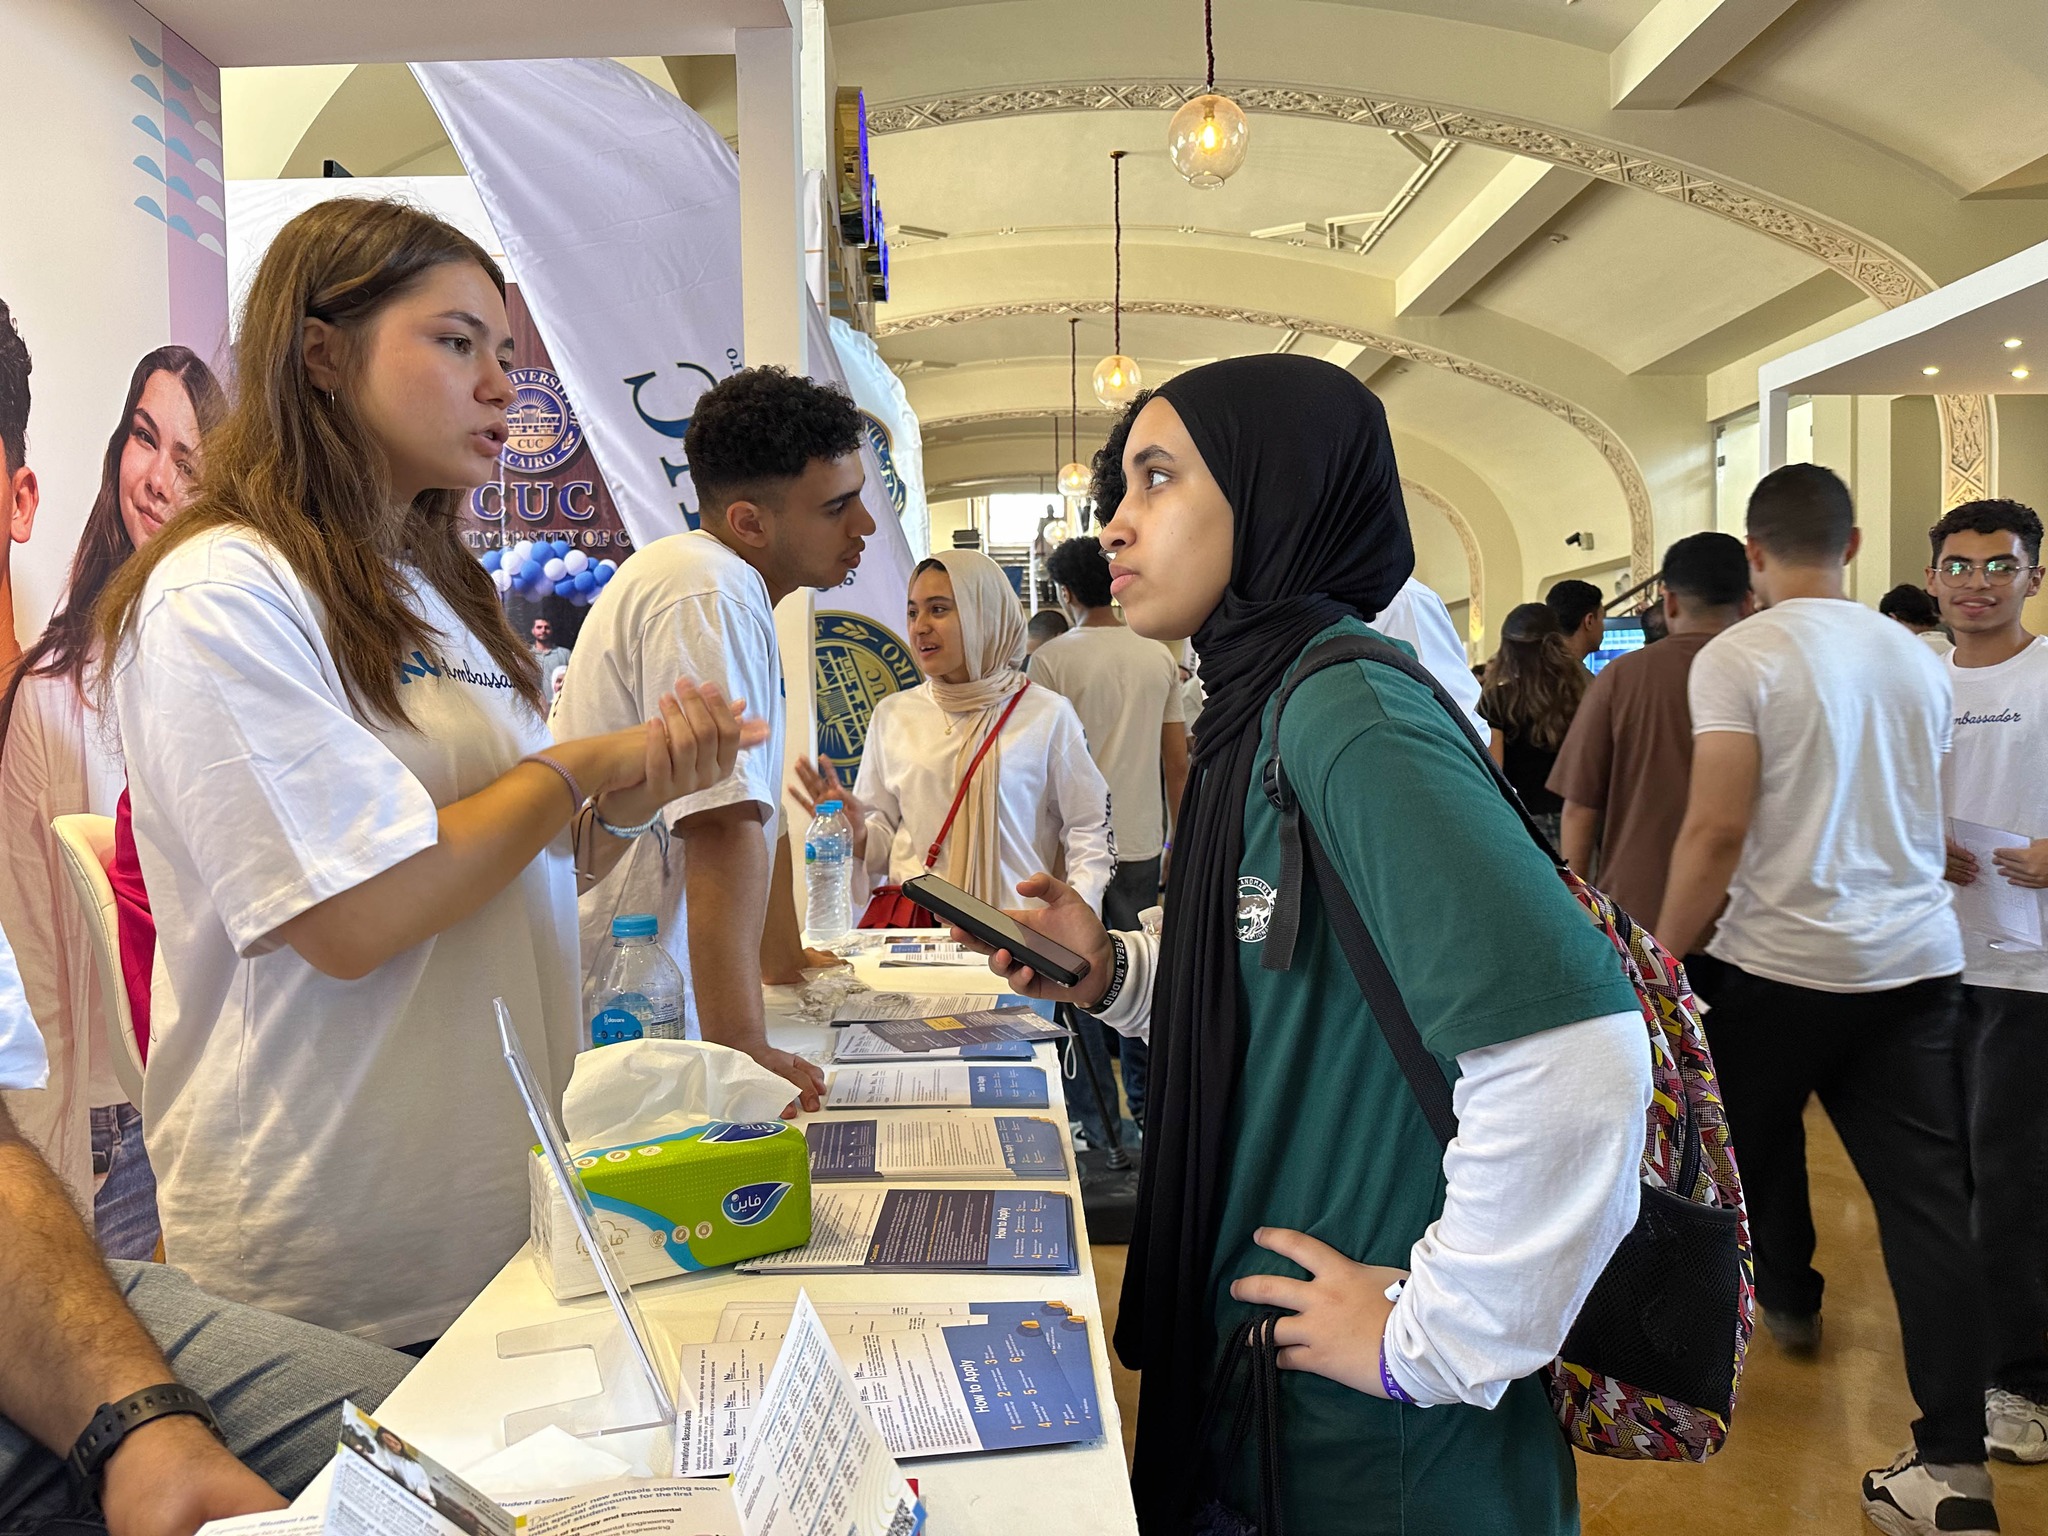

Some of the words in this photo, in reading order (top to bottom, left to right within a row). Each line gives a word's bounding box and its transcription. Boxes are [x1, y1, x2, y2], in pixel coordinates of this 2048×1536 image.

[517, 438, 544, 449] CUC
[506, 453, 556, 468] CAIRO
[471, 480, 595, 520] CUC
[581, 529, 611, 548] OF
[1953, 708, 2022, 725] mbassador
[1240, 878, 1271, 897] ANDMARK
[1114, 940, 1125, 966] REAL
[1103, 967, 1125, 1006] MADRID
[729, 1194, 762, 1213] فاين
[997, 1206, 1011, 1220] Apply
[995, 1227, 1007, 1239] How
[960, 1359, 980, 1382] Apply
[969, 1385, 982, 1393] to
[974, 1395, 990, 1413] How
[680, 1441, 691, 1471] International
[570, 1501, 588, 1510] our
[590, 1494, 610, 1504] new
[612, 1487, 651, 1498] schools
[527, 1520, 549, 1532] with
[551, 1507, 587, 1523] special
[588, 1494, 638, 1510] discounts
[571, 1519, 602, 1532] Energy
[603, 1514, 620, 1522] and
[621, 1507, 682, 1518] Environmental
[573, 1505, 620, 1522] students.
[622, 1525, 671, 1535] Engineering
[626, 1518, 675, 1528] Engineering
